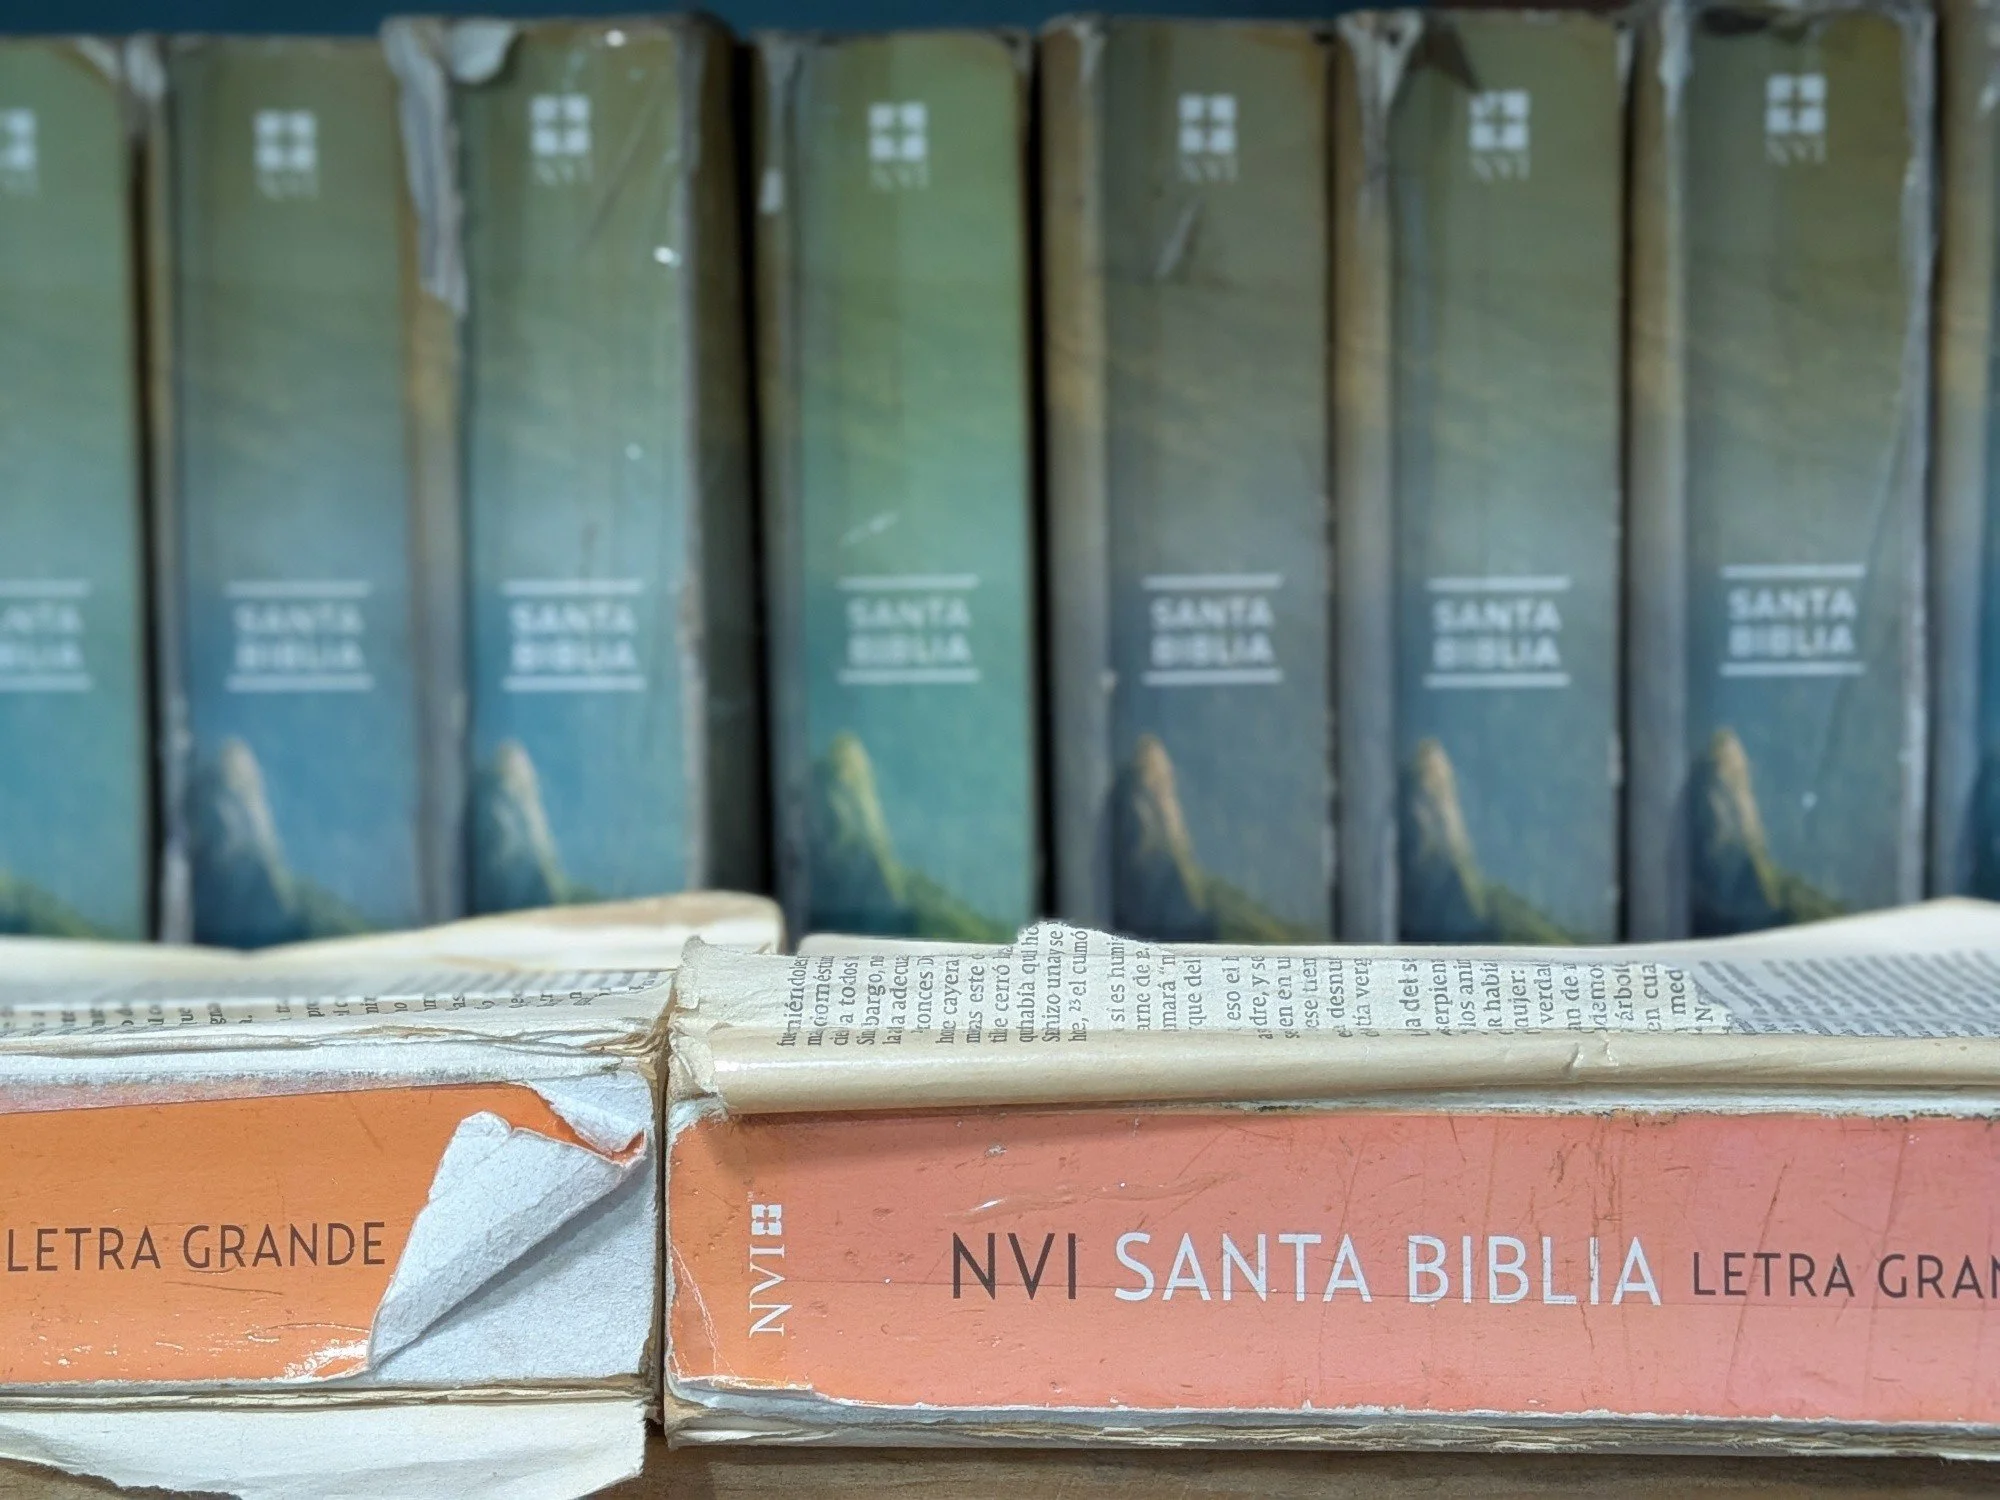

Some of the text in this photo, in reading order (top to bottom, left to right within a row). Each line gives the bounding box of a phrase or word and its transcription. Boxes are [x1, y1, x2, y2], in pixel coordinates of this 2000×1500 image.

[967, 965, 985, 1003] este
[1131, 964, 1151, 987] de
[1182, 959, 1202, 987] del
[1252, 974, 1270, 988] y
[1277, 975, 1292, 1000] en
[991, 964, 1010, 1012] cerró
[1110, 984, 1125, 1004] es
[1397, 978, 1420, 1012] del
[1560, 976, 1580, 1001] de
[1664, 969, 1687, 1015] med
[1226, 990, 1241, 1021] eso
[1278, 1005, 1293, 1027] en
[1457, 1001, 1476, 1027] los
[7, 1222, 385, 1272] LETRA GRANDE
[952, 1232, 1076, 1300] NVI
[1114, 1232, 1373, 1303] SANTA
[1408, 1234, 1662, 1306] BIBLIA
[1693, 1251, 1855, 1297] LETRA
[749, 1244, 792, 1338] NVI
